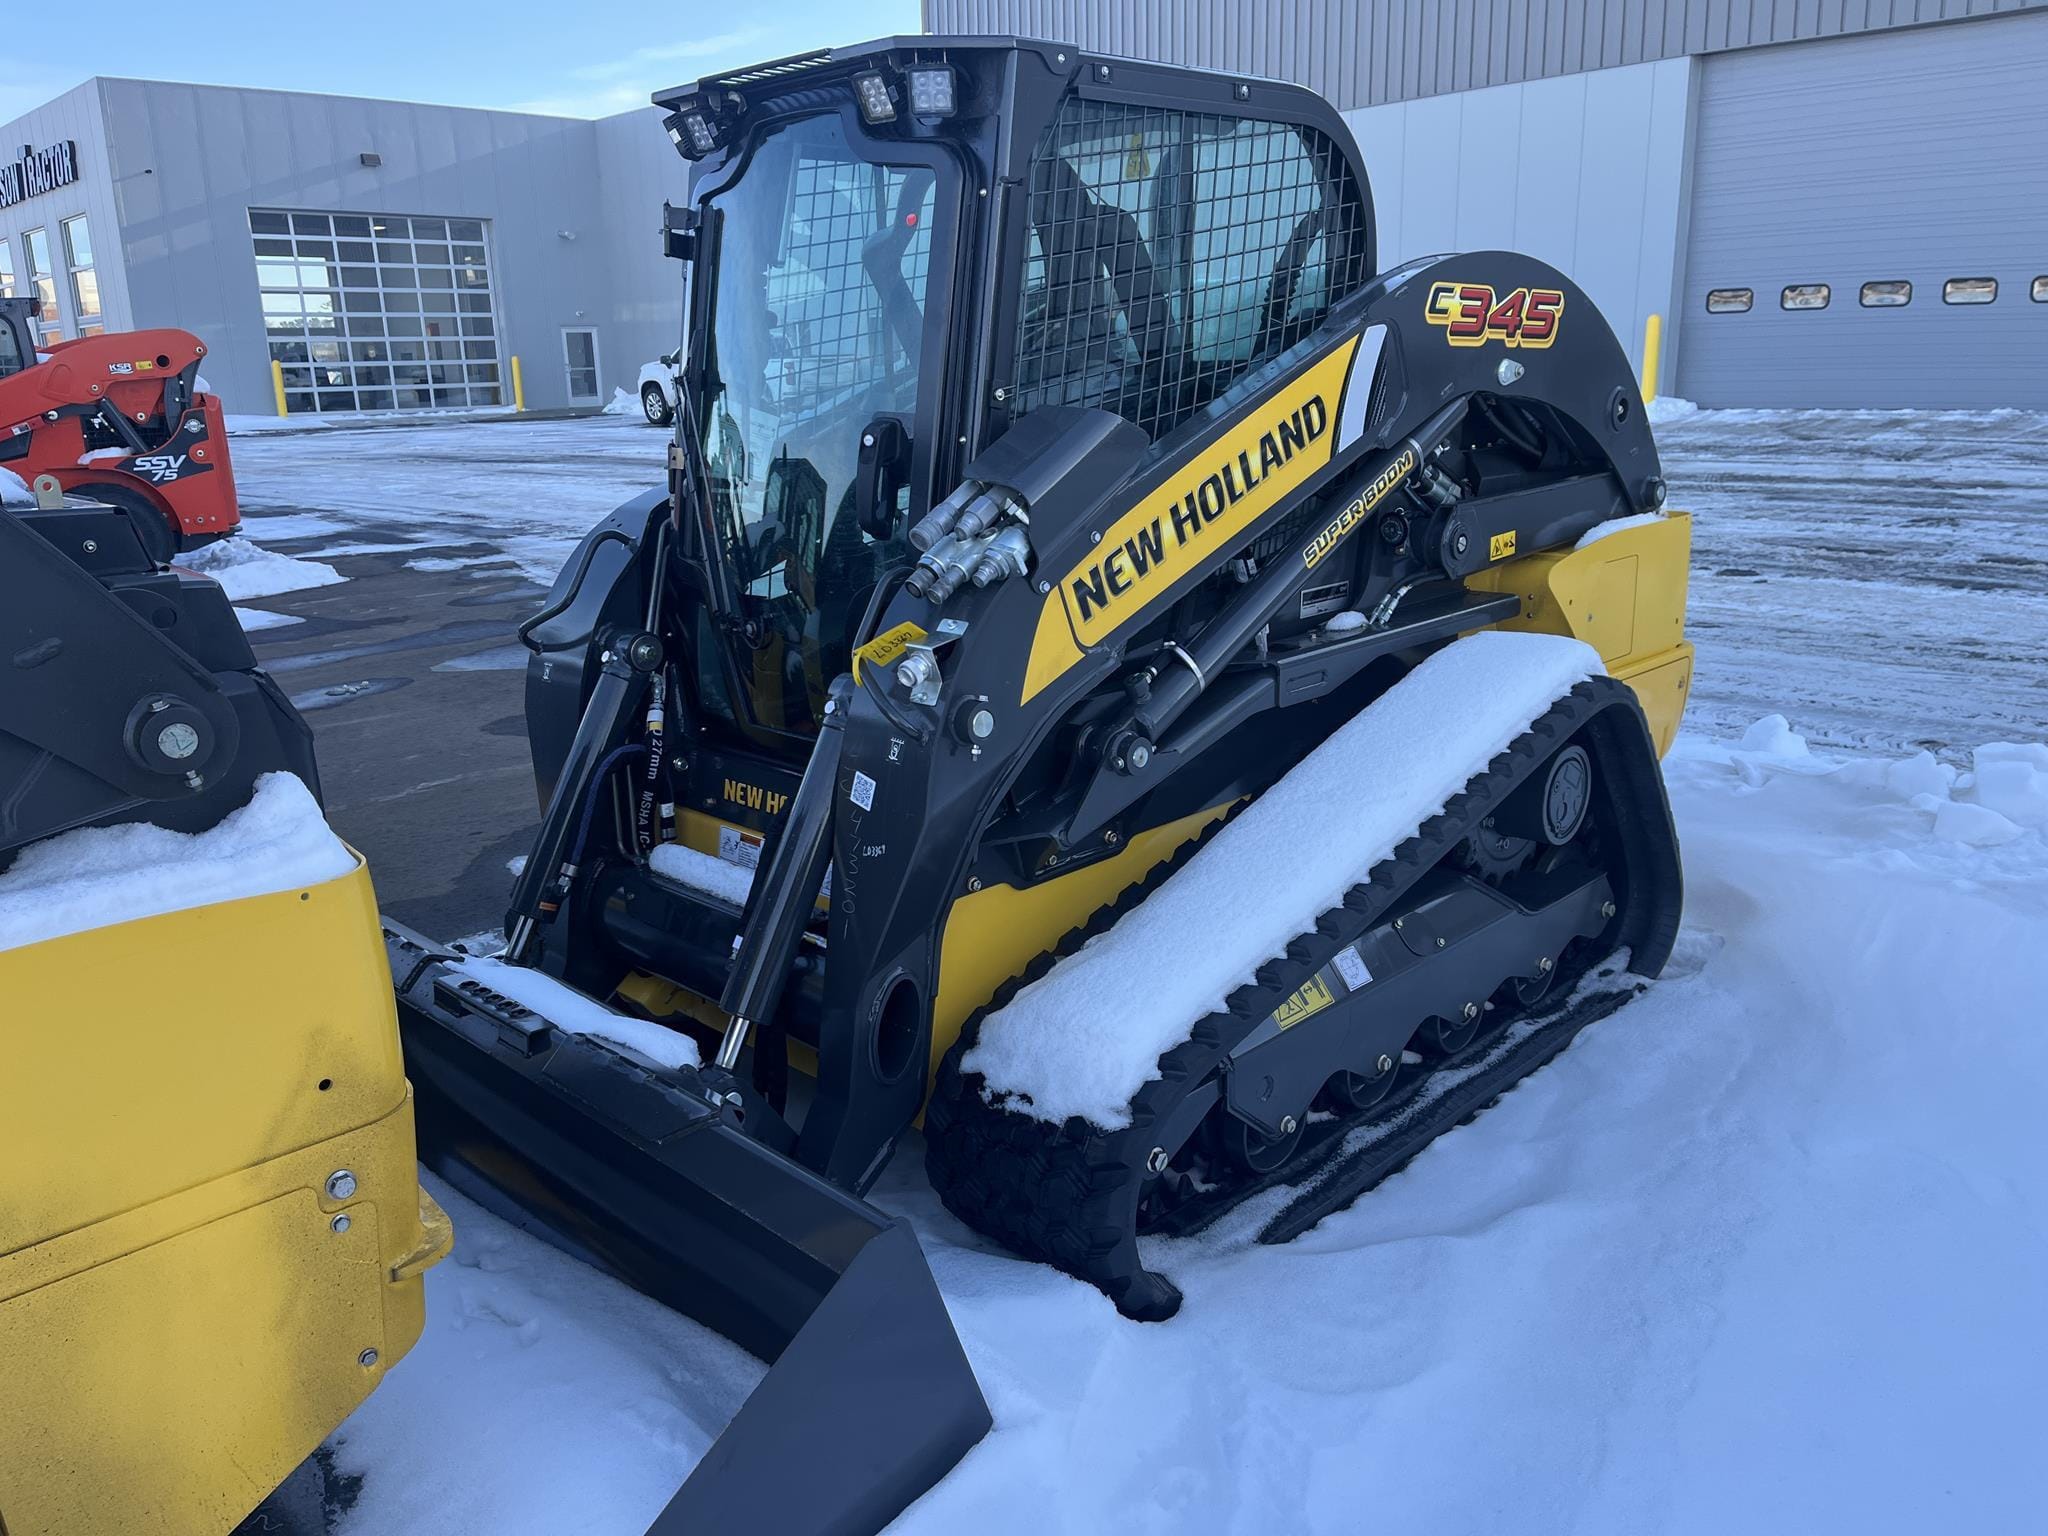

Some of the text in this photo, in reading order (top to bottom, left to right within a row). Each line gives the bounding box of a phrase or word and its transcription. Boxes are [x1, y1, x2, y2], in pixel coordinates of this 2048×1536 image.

[17, 140, 76, 198] TRACTOR
[133, 455, 187, 471] SSV
[151, 469, 178, 481] 75
[1072, 395, 1327, 622] NEW HOLLAND
[1303, 450, 1413, 568] SUPER BOOM
[638, 790, 654, 826] MSHA
[723, 778, 764, 810] NEW
